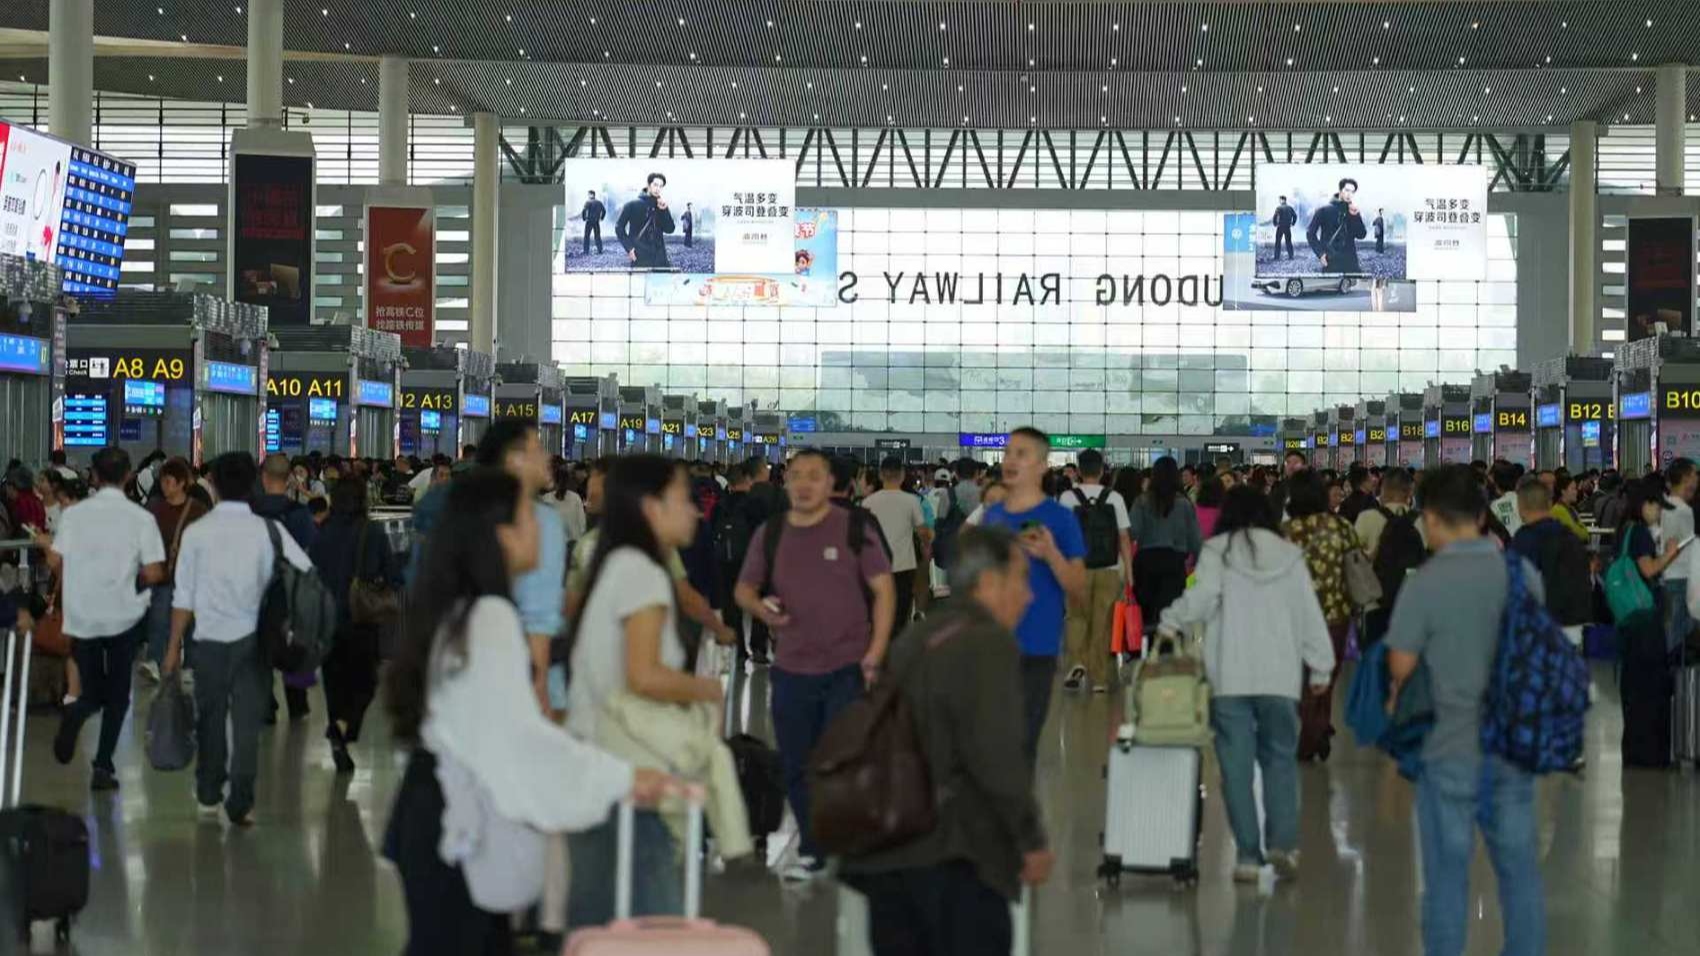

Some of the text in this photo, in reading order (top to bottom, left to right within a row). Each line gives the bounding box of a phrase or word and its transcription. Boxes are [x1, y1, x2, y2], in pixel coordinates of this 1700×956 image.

[733, 192, 778, 204] 气温多变
[1425, 198, 1470, 210] 气温多变
[113, 357, 144, 379] A8
[152, 359, 184, 380] A9
[267, 378, 302, 396] A10
[308, 379, 342, 397] A11
[400, 393, 453, 410] 12 A13
[1666, 391, 1700, 409] B10
[506, 404, 534, 418] A15
[1570, 404, 1601, 419] B12
[570, 411, 595, 424] A17
[1499, 412, 1526, 426] B14
[621, 419, 643, 429] A19
[661, 423, 680, 433] A21
[1446, 420, 1470, 432] B16
[1370, 430, 1385, 440] B2
[1403, 426, 1424, 436] B18
[1317, 436, 1328, 445] B2
[1341, 433, 1353, 443] B2
